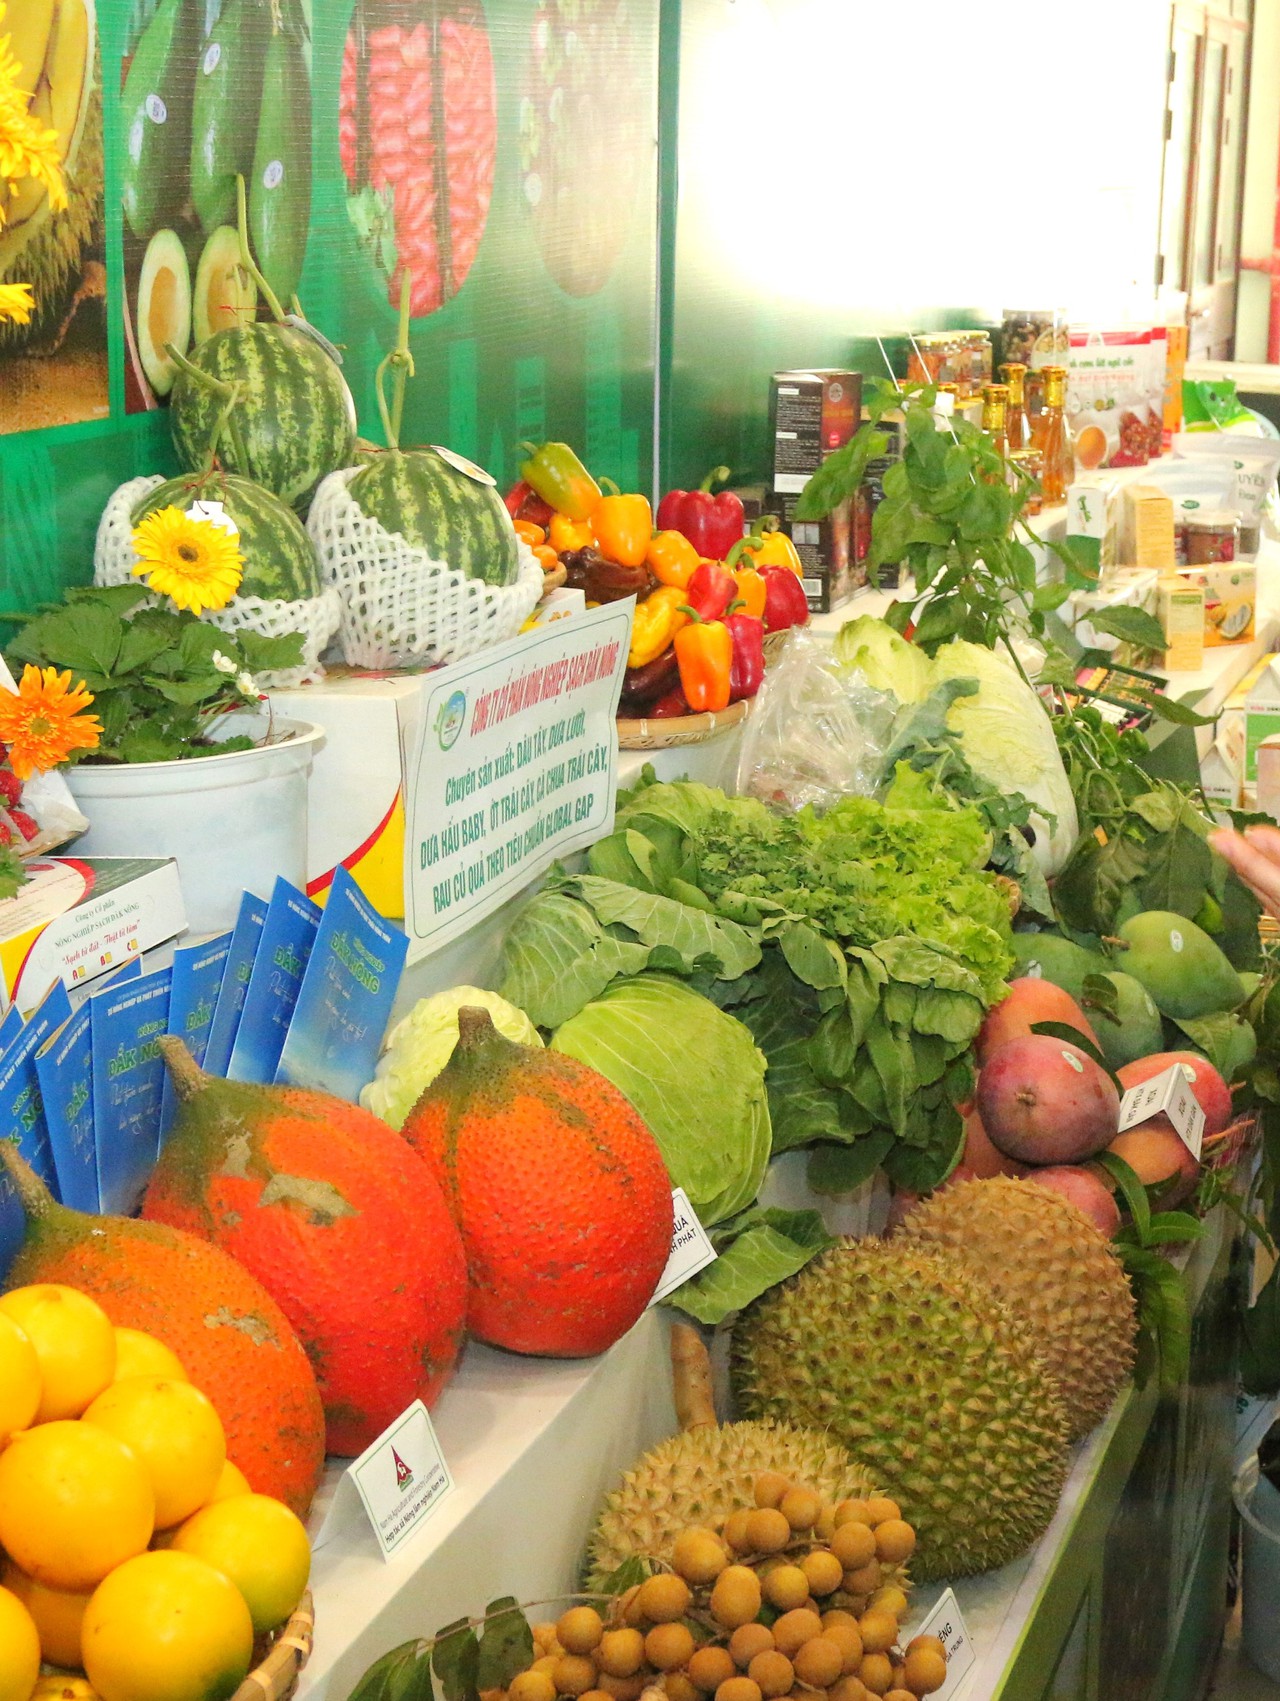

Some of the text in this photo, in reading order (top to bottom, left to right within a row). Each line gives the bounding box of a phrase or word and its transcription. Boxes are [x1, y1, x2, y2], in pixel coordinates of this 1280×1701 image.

[420, 833, 439, 871] DƯA
[441, 815, 460, 859] HẤU
[461, 809, 487, 848] BABY,
[500, 786, 519, 825] TRÁI
[546, 762, 565, 796] CHUA
[567, 749, 585, 785] TRÁI
[587, 742, 608, 774] CÂY,
[445, 767, 476, 807] Chuyên
[478, 755, 493, 789] sản
[494, 742, 515, 781] xuất:
[516, 734, 532, 769] DÂU
[548, 719, 566, 752] DƯA
[433, 877, 451, 915] RAU
[453, 861, 466, 902] CỦ
[468, 850, 485, 896] QUẢ
[486, 846, 505, 882] THEO
[506, 832, 523, 869] TIÊU
[545, 803, 573, 839] GLOBAL
[575, 793, 594, 823] GAP
[678, 1228, 697, 1248] PHÁT
[937, 1622, 952, 1644] ÊNG
